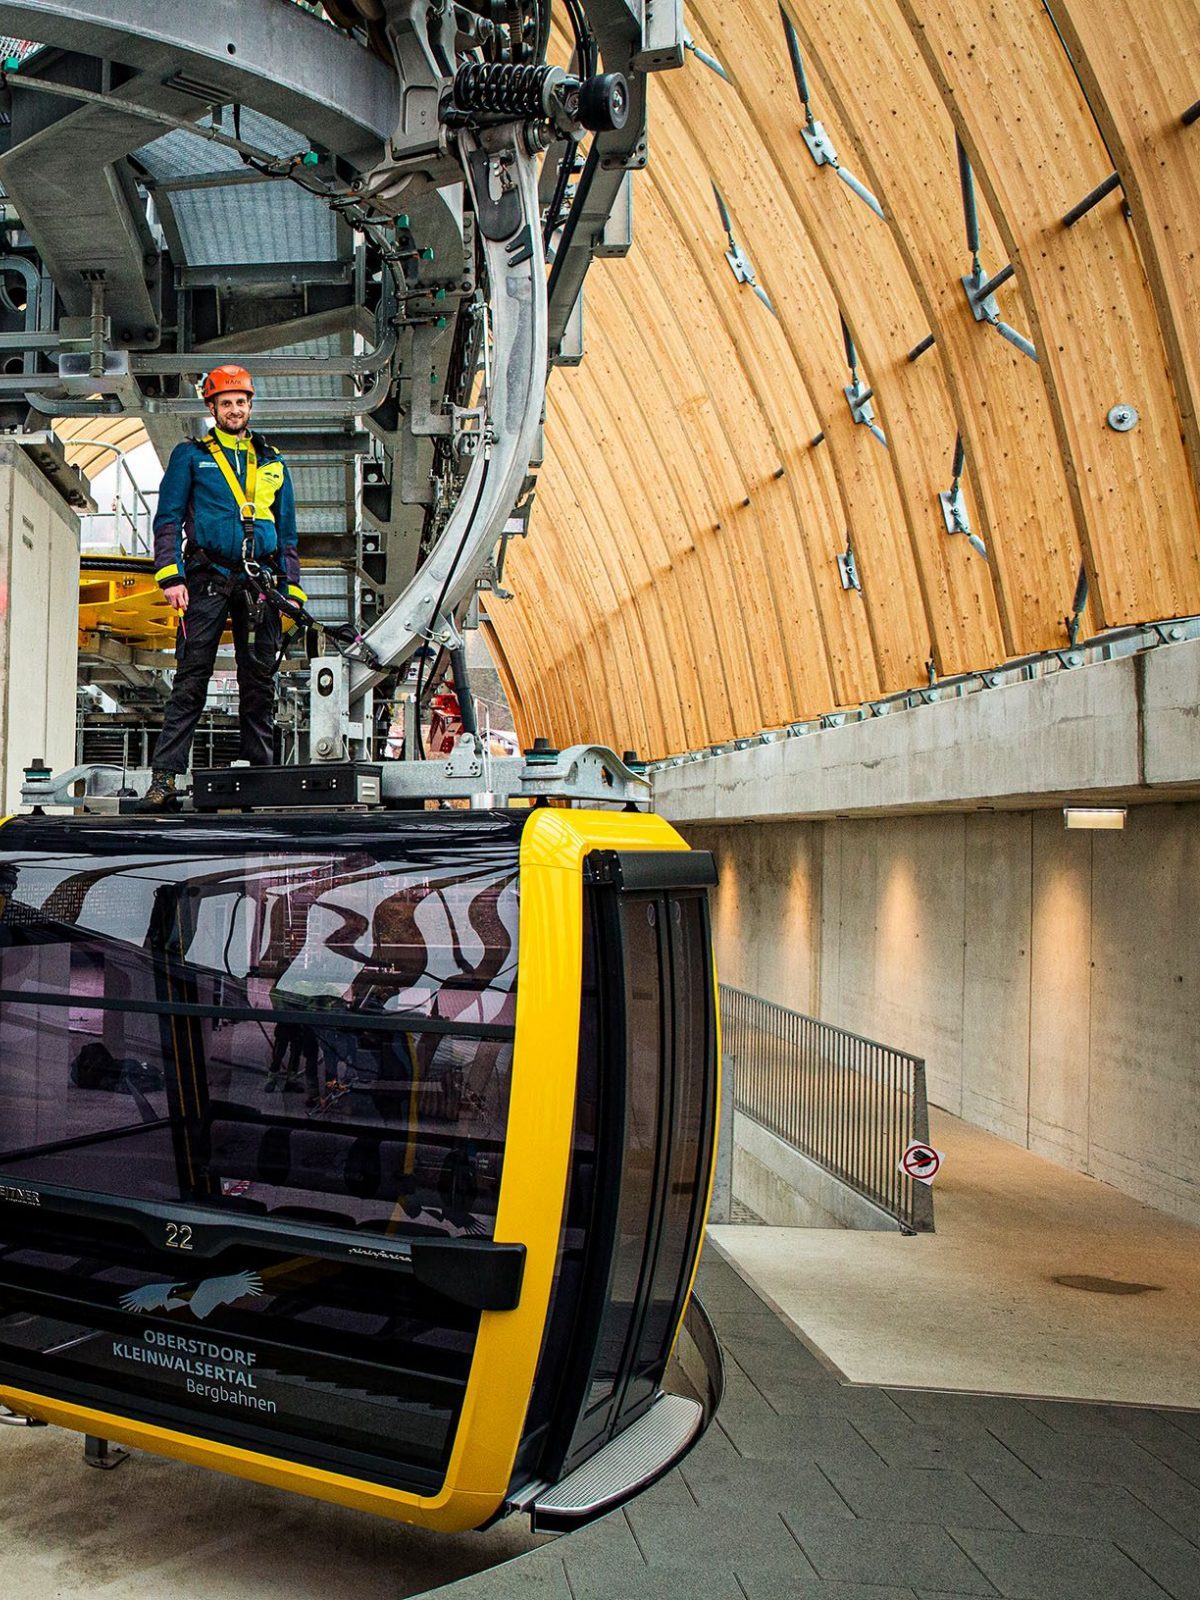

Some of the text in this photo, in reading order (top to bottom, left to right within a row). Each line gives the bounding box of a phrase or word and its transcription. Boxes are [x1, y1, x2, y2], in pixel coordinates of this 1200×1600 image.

[165, 1222, 193, 1250] 22
[113, 1342, 257, 1389] KLEINWALSERTAL
[143, 1330, 257, 1366] OBERSTDORF
[186, 1378, 277, 1414] Bergbahnen
